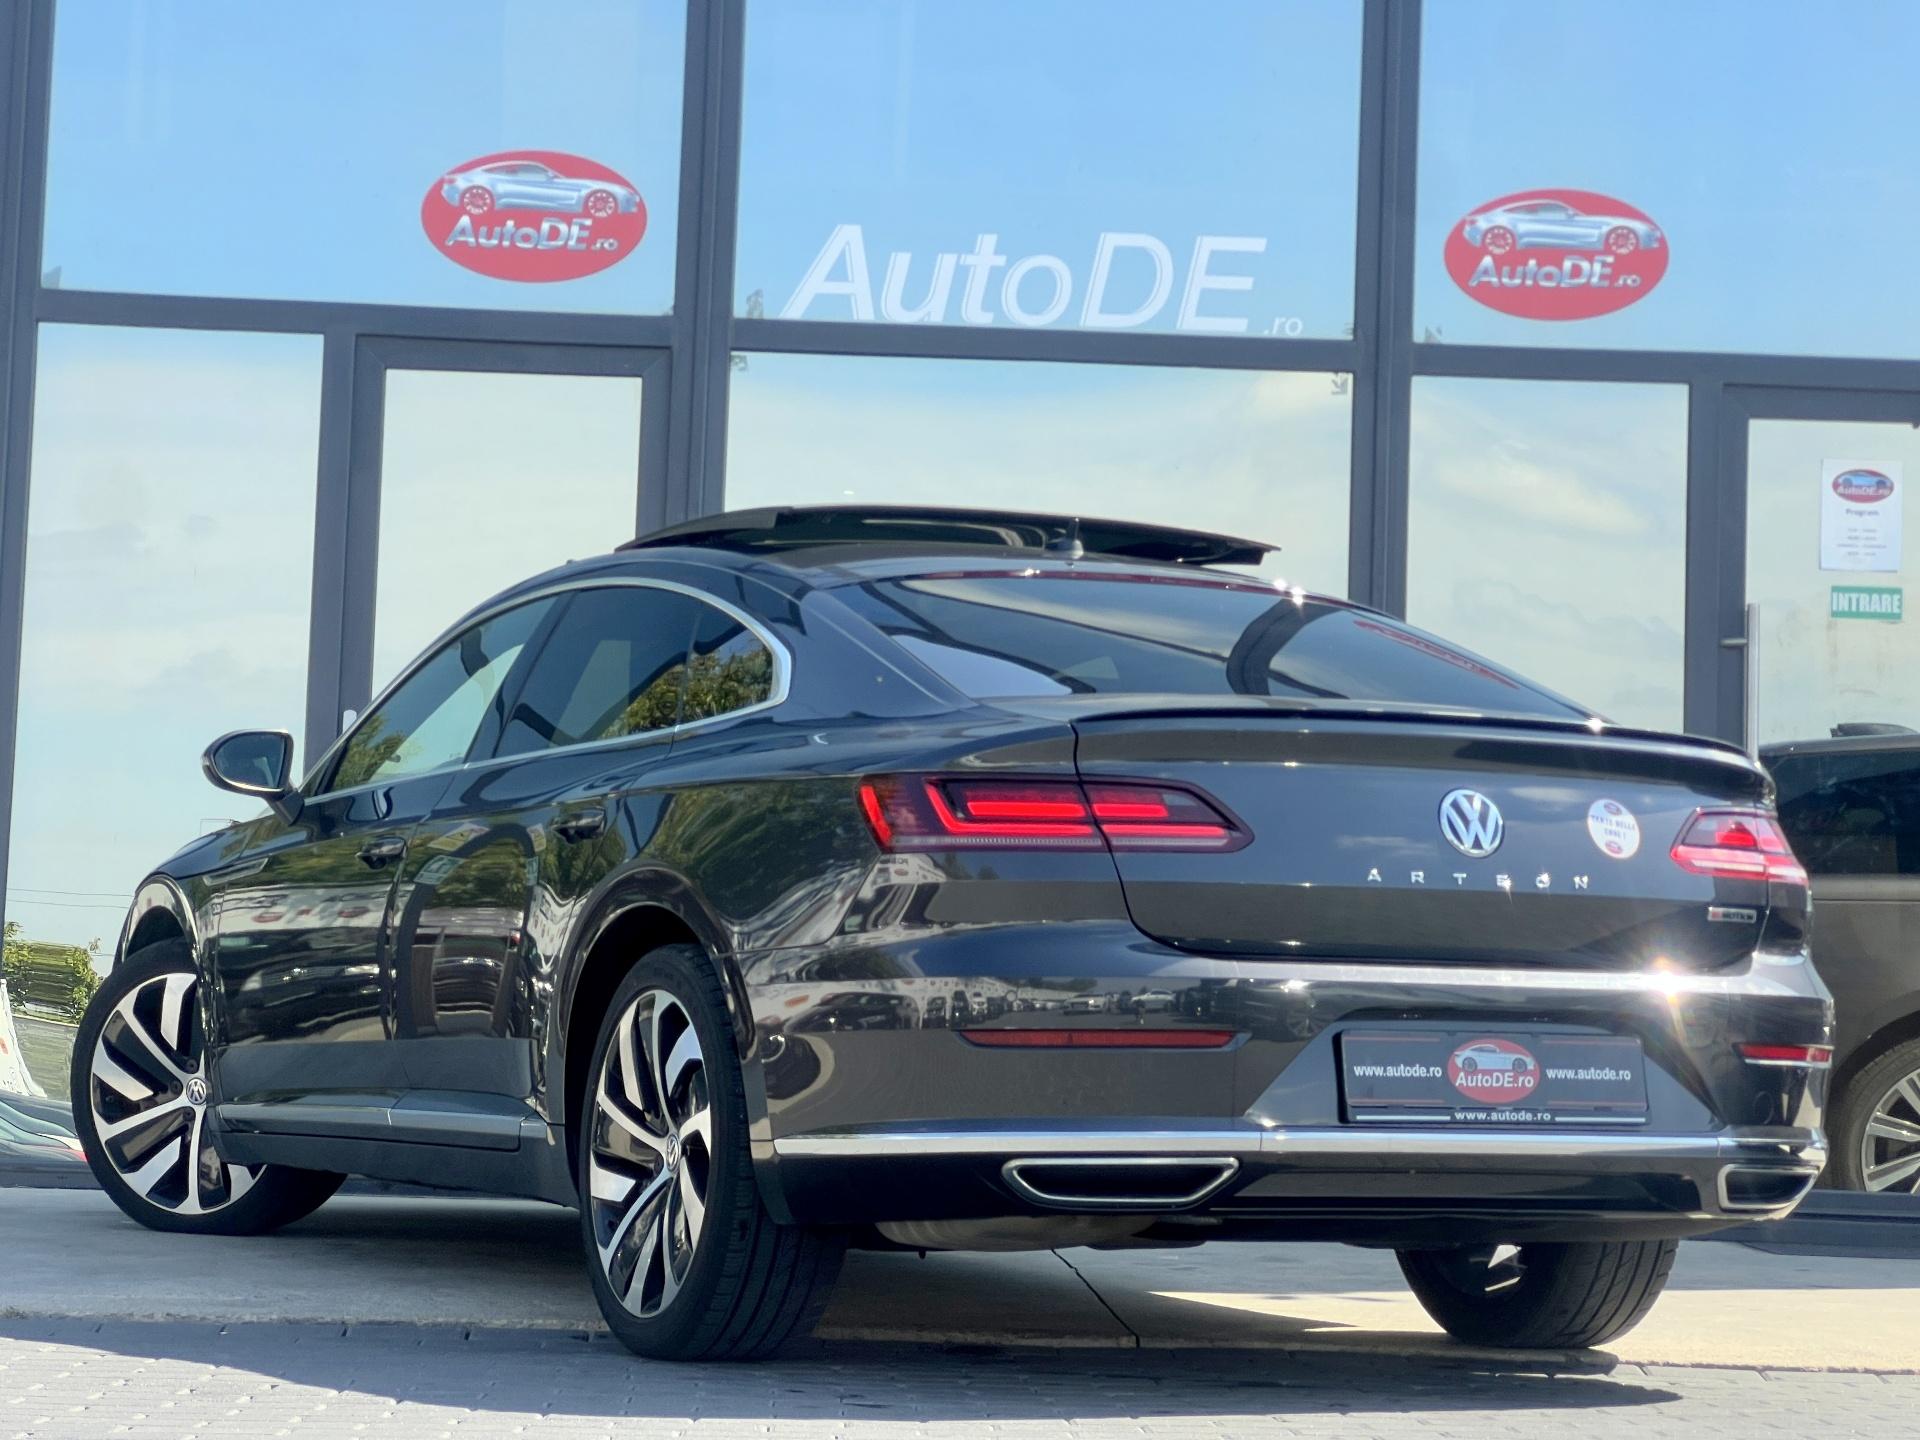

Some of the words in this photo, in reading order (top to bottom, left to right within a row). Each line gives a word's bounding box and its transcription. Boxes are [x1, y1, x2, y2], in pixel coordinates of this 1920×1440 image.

[1832, 591, 1901, 613] INTRARE
[1440, 789, 1503, 857] VW
[1367, 867, 1590, 890] ARTEON
[1353, 1063, 1442, 1077] www.autode.ro
[1546, 1067, 1631, 1081] www.autode.ro
[1455, 1071, 1534, 1088] AutoDE.ro
[1454, 1109, 1551, 1121] www.autode.ro
